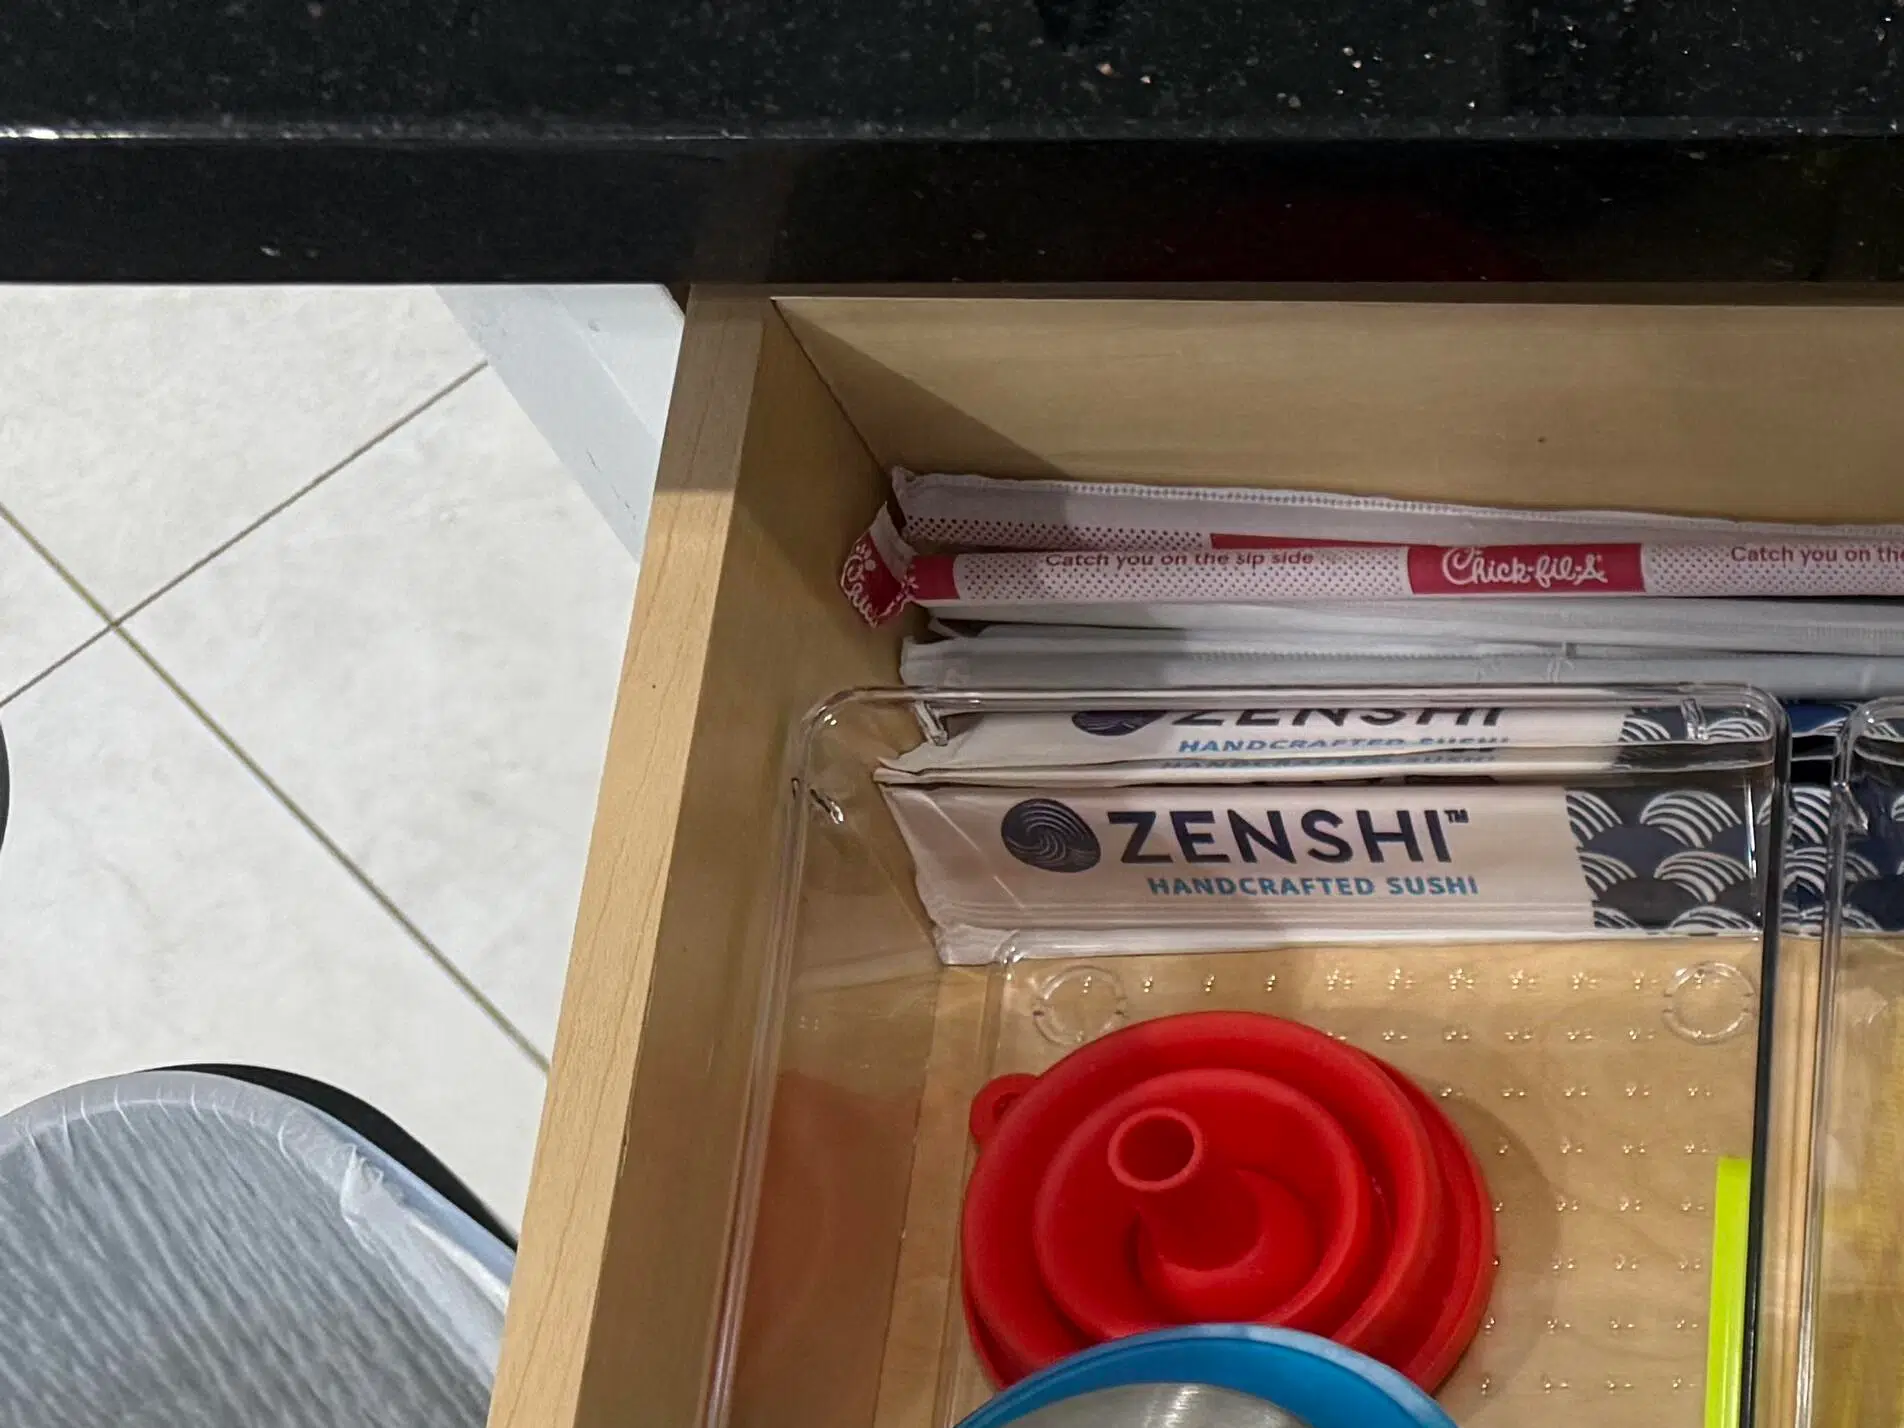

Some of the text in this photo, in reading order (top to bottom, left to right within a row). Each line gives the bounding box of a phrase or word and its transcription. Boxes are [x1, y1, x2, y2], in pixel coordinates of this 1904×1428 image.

[1046, 550, 1314, 571] Catch you on the sip side
[1731, 545, 1796, 563] Catch
[1800, 547, 1840, 567] you
[1844, 547, 1873, 562] on
[1147, 876, 1479, 896] HANDCRAFTED SUSHI
